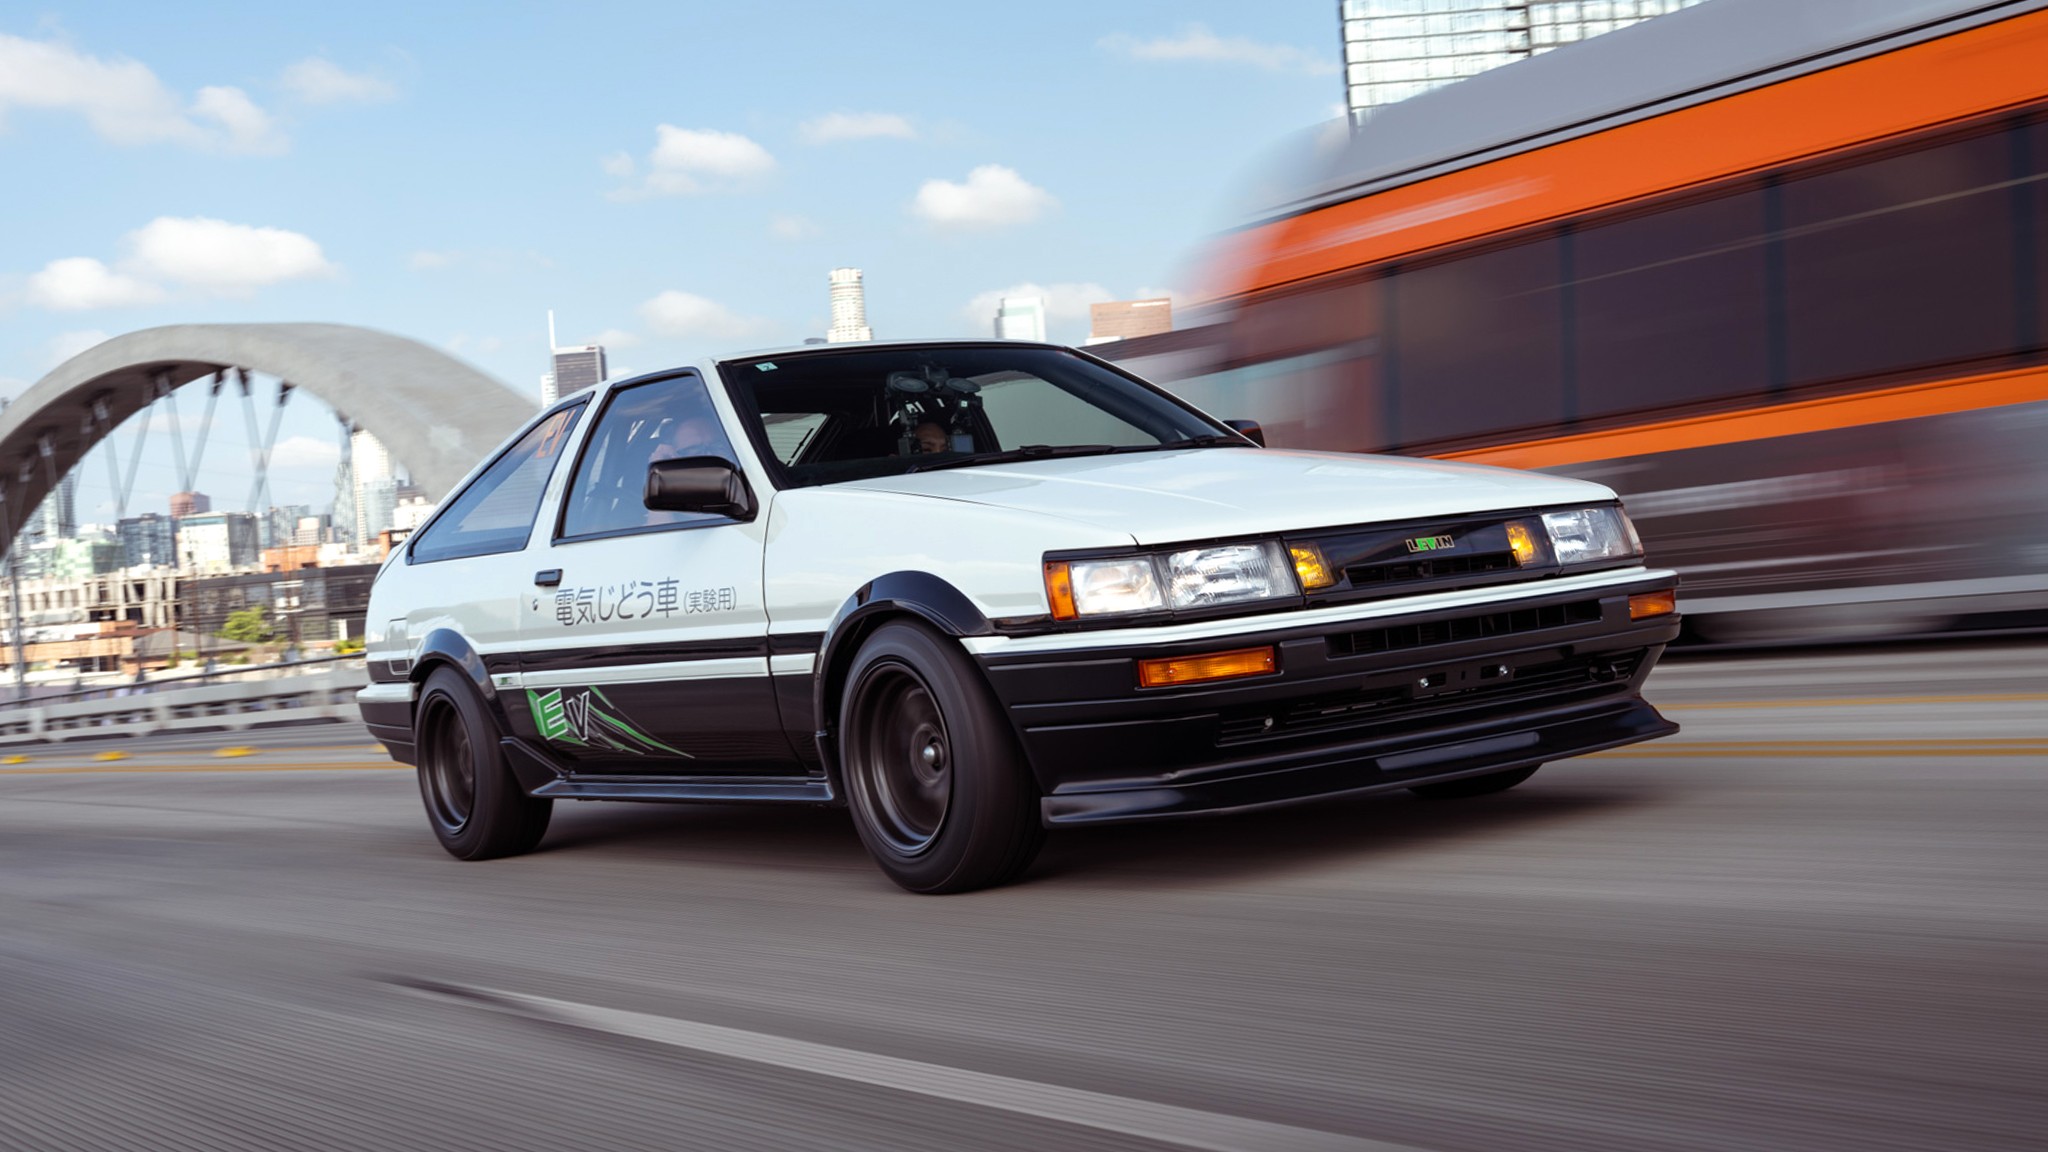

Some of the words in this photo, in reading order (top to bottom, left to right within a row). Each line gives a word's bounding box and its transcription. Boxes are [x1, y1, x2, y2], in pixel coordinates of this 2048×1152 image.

[1406, 535, 1455, 553] LEVIN
[555, 577, 679, 626] 電気じどう車
[684, 586, 737, 615] (実験用)
[537, 688, 590, 741] EV
